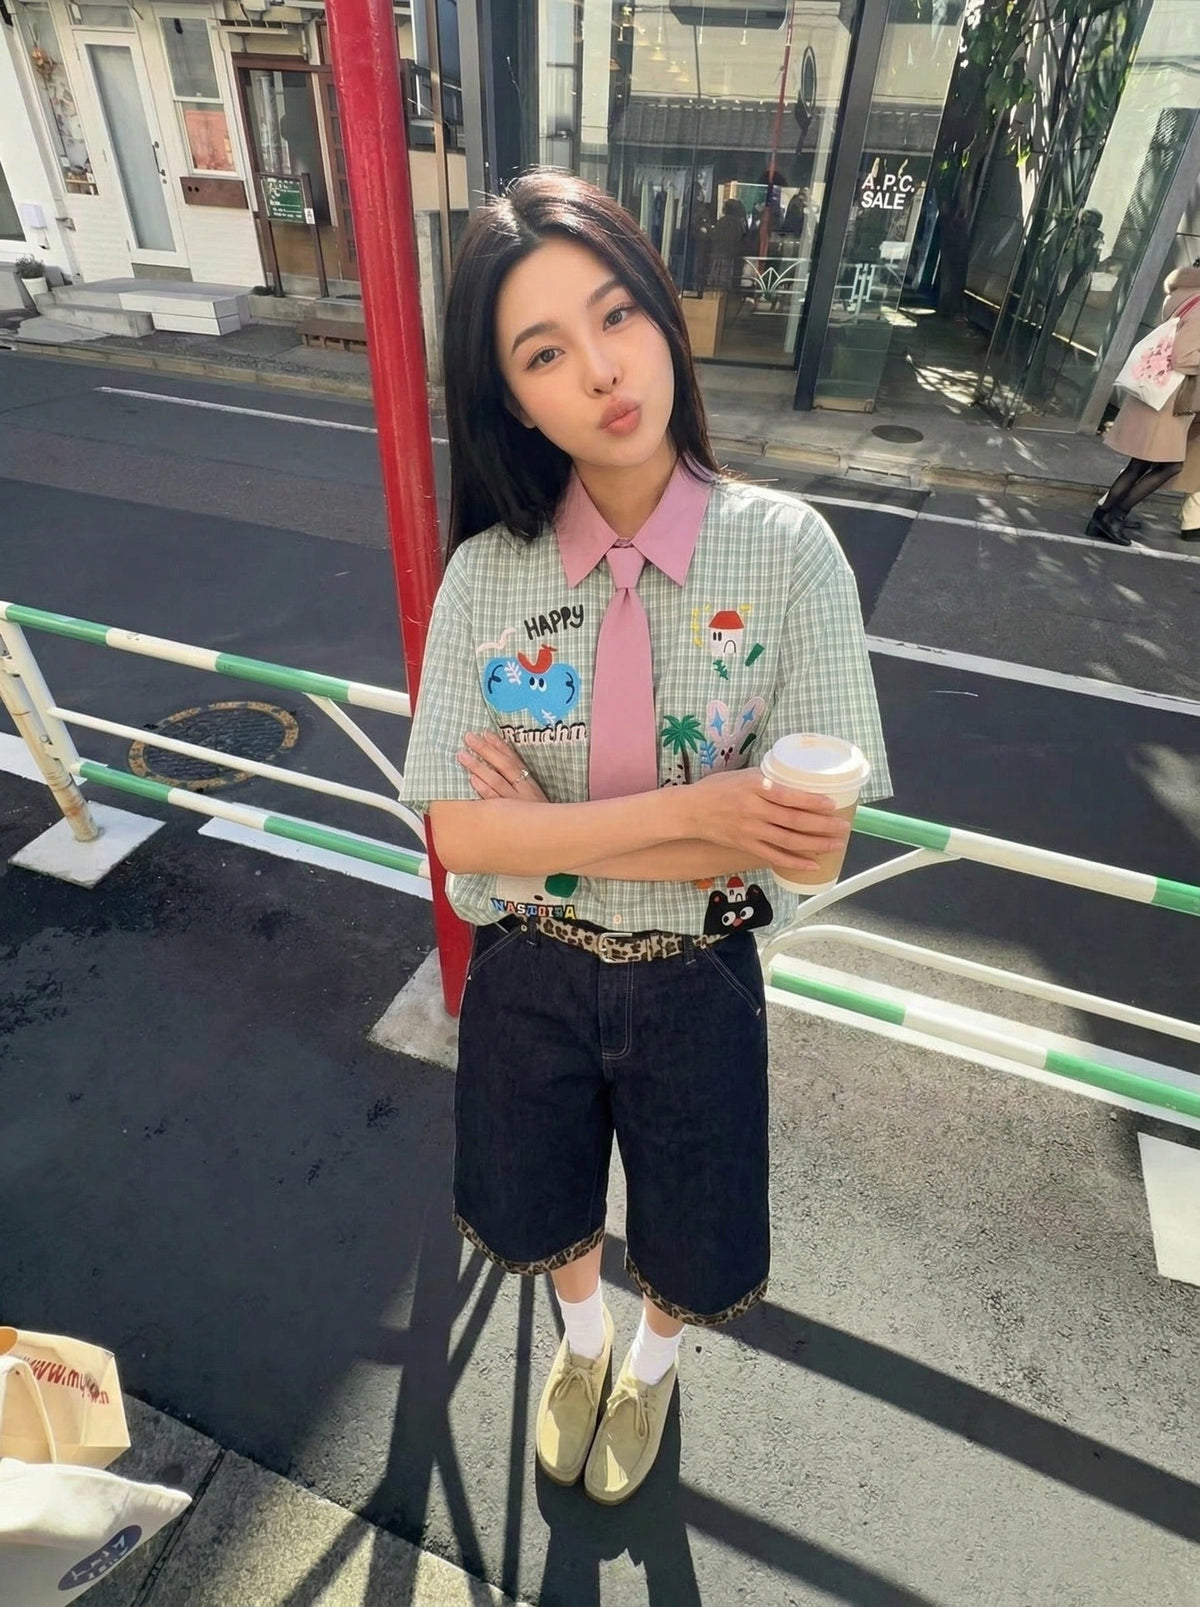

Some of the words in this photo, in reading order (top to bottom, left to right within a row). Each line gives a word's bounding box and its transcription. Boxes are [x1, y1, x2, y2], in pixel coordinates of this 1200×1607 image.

[861, 173, 915, 192] A.P.C.
[861, 191, 906, 209] SALE
[524, 604, 584, 640] HAPPY
